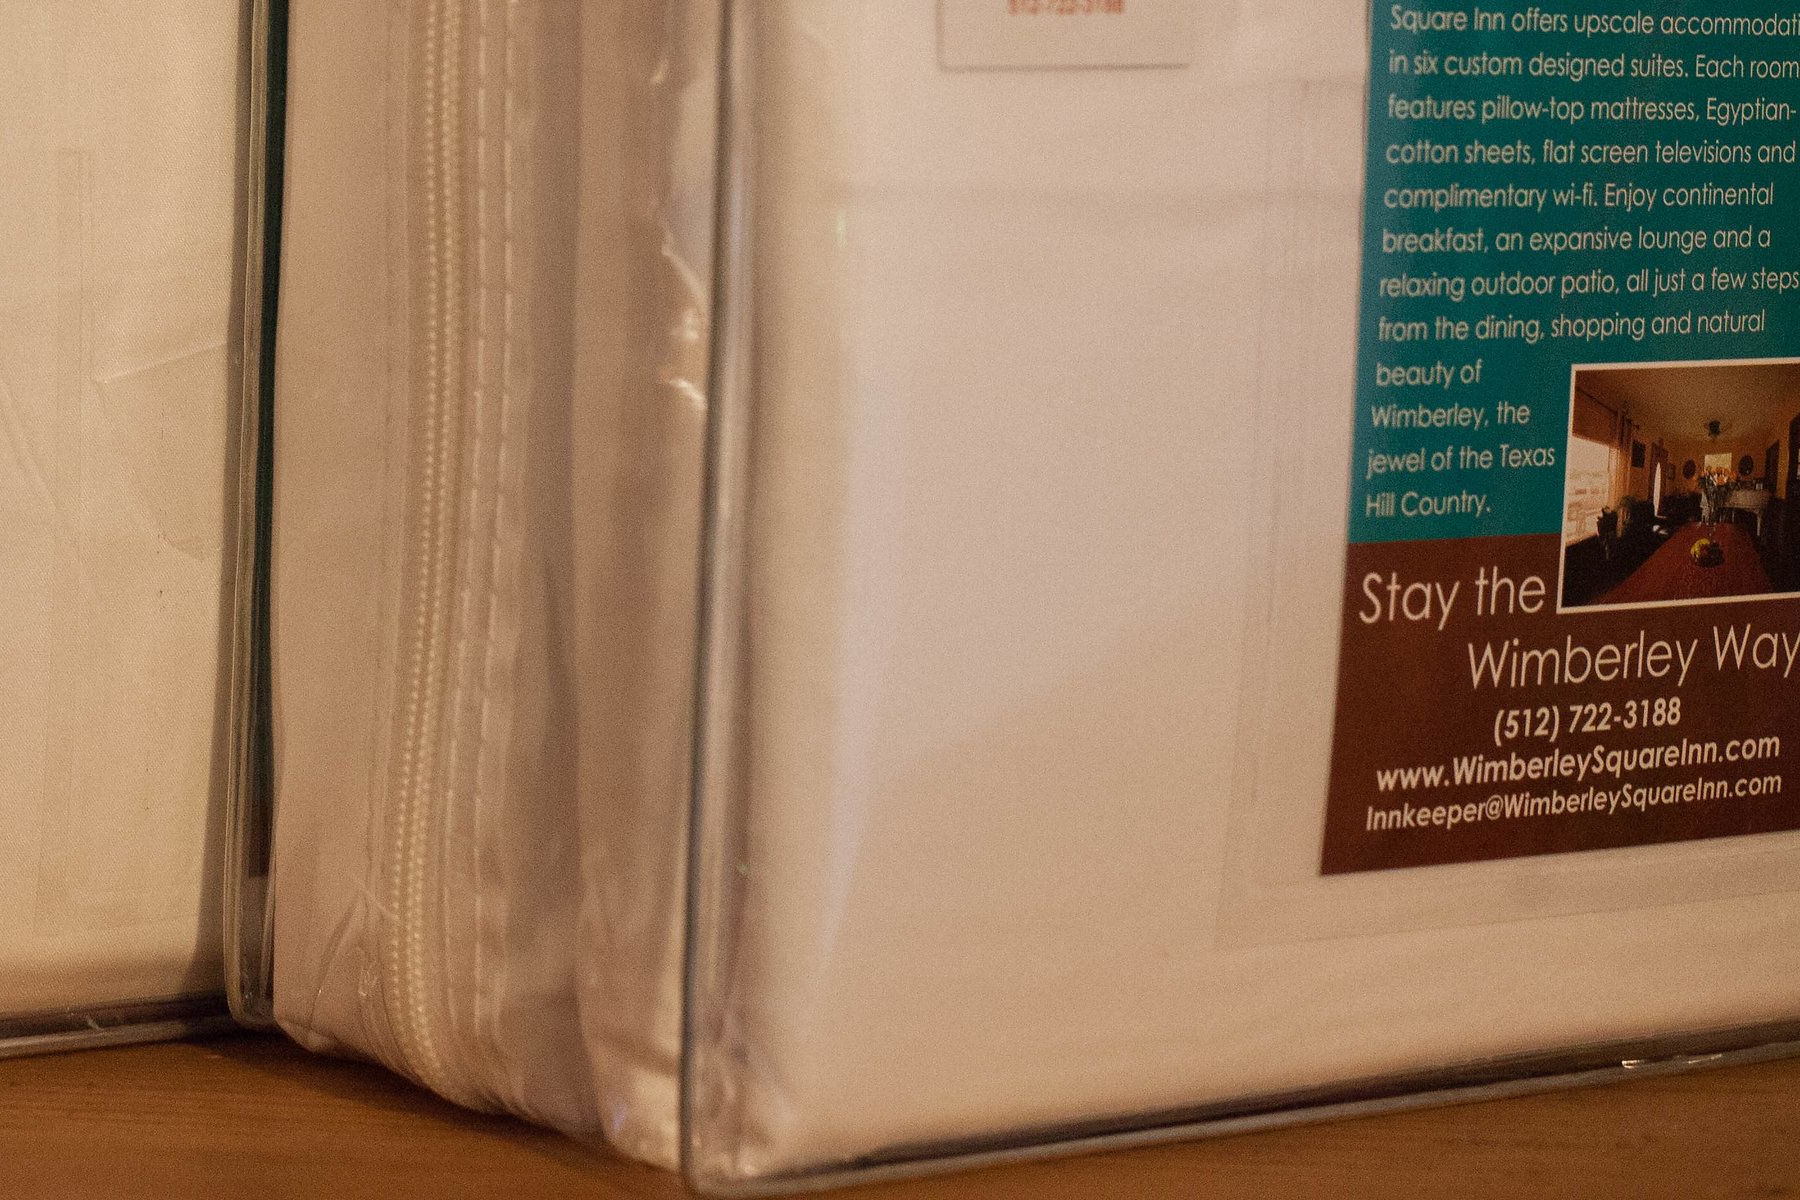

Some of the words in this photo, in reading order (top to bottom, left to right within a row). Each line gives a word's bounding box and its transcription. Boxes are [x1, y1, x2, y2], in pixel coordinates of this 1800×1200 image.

[1391, 5, 1466, 33] Square
[1474, 7, 1505, 31] Inn
[1512, 8, 1567, 33] offers
[1575, 11, 1653, 37] upscale
[1389, 50, 1407, 74] in
[1414, 50, 1438, 74] six
[1445, 52, 1522, 76] custom
[1529, 53, 1624, 81] designed
[1631, 54, 1688, 77] suites.
[1696, 55, 1743, 78] Each
[1388, 95, 1475, 120] features
[1482, 95, 1583, 124] pillow-top
[1591, 98, 1699, 122] mattresses,
[1707, 98, 1796, 125] Egyptian-
[1387, 141, 1457, 163] cotton
[1465, 140, 1535, 165] sheets,
[1543, 140, 1574, 163] flat
[1581, 144, 1648, 163] screen
[1655, 140, 1750, 163] televisions
[1757, 140, 1795, 163] and
[1384, 182, 1546, 212] complimentary
[1553, 182, 1597, 206] wi-fi.
[1606, 184, 1656, 211] Enjoy
[1663, 182, 1773, 206] continental
[1383, 228, 1487, 254] breakfast,
[1496, 231, 1522, 251] an
[1530, 226, 1632, 254] expansive
[1638, 226, 1706, 254] lounge
[1714, 225, 1751, 248] and
[1759, 229, 1770, 248] a
[1380, 272, 1465, 301] relaxing
[1471, 271, 1555, 295] outdoor
[1562, 270, 1619, 298] patio,
[1627, 269, 1648, 292] all
[1653, 269, 1684, 297] just
[1692, 273, 1703, 290] a
[1711, 266, 1744, 289] few
[1752, 266, 1798, 294] steps
[1379, 317, 1427, 341] from
[1435, 316, 1467, 339] the
[1476, 315, 1544, 343] dining,
[1551, 311, 1644, 342] shopping
[1652, 311, 1690, 334] and
[1697, 310, 1765, 333] natural
[1377, 361, 1453, 389] beauty
[1460, 359, 1482, 384] of
[1372, 403, 1488, 431] Wimberley,
[1497, 401, 1530, 425] the
[1366, 449, 1425, 478] jewel
[1431, 447, 1453, 470] of
[1460, 446, 1492, 469] the
[1500, 444, 1554, 467] Texas
[1366, 494, 1395, 517] Hill
[1402, 493, 1490, 516] Country.
[1359, 570, 1459, 630] Stay
[1475, 566, 1546, 615] the
[1468, 629, 1698, 689] Wimberley
[1713, 624, 1800, 677] Way
[1494, 705, 1559, 746] (512)
[1568, 697, 1681, 734] 722-3188
[1377, 735, 1780, 791] www.WimberleySquareInn.com
[1366, 776, 1781, 831] Innkeeper@WimberleySquareInn.com
